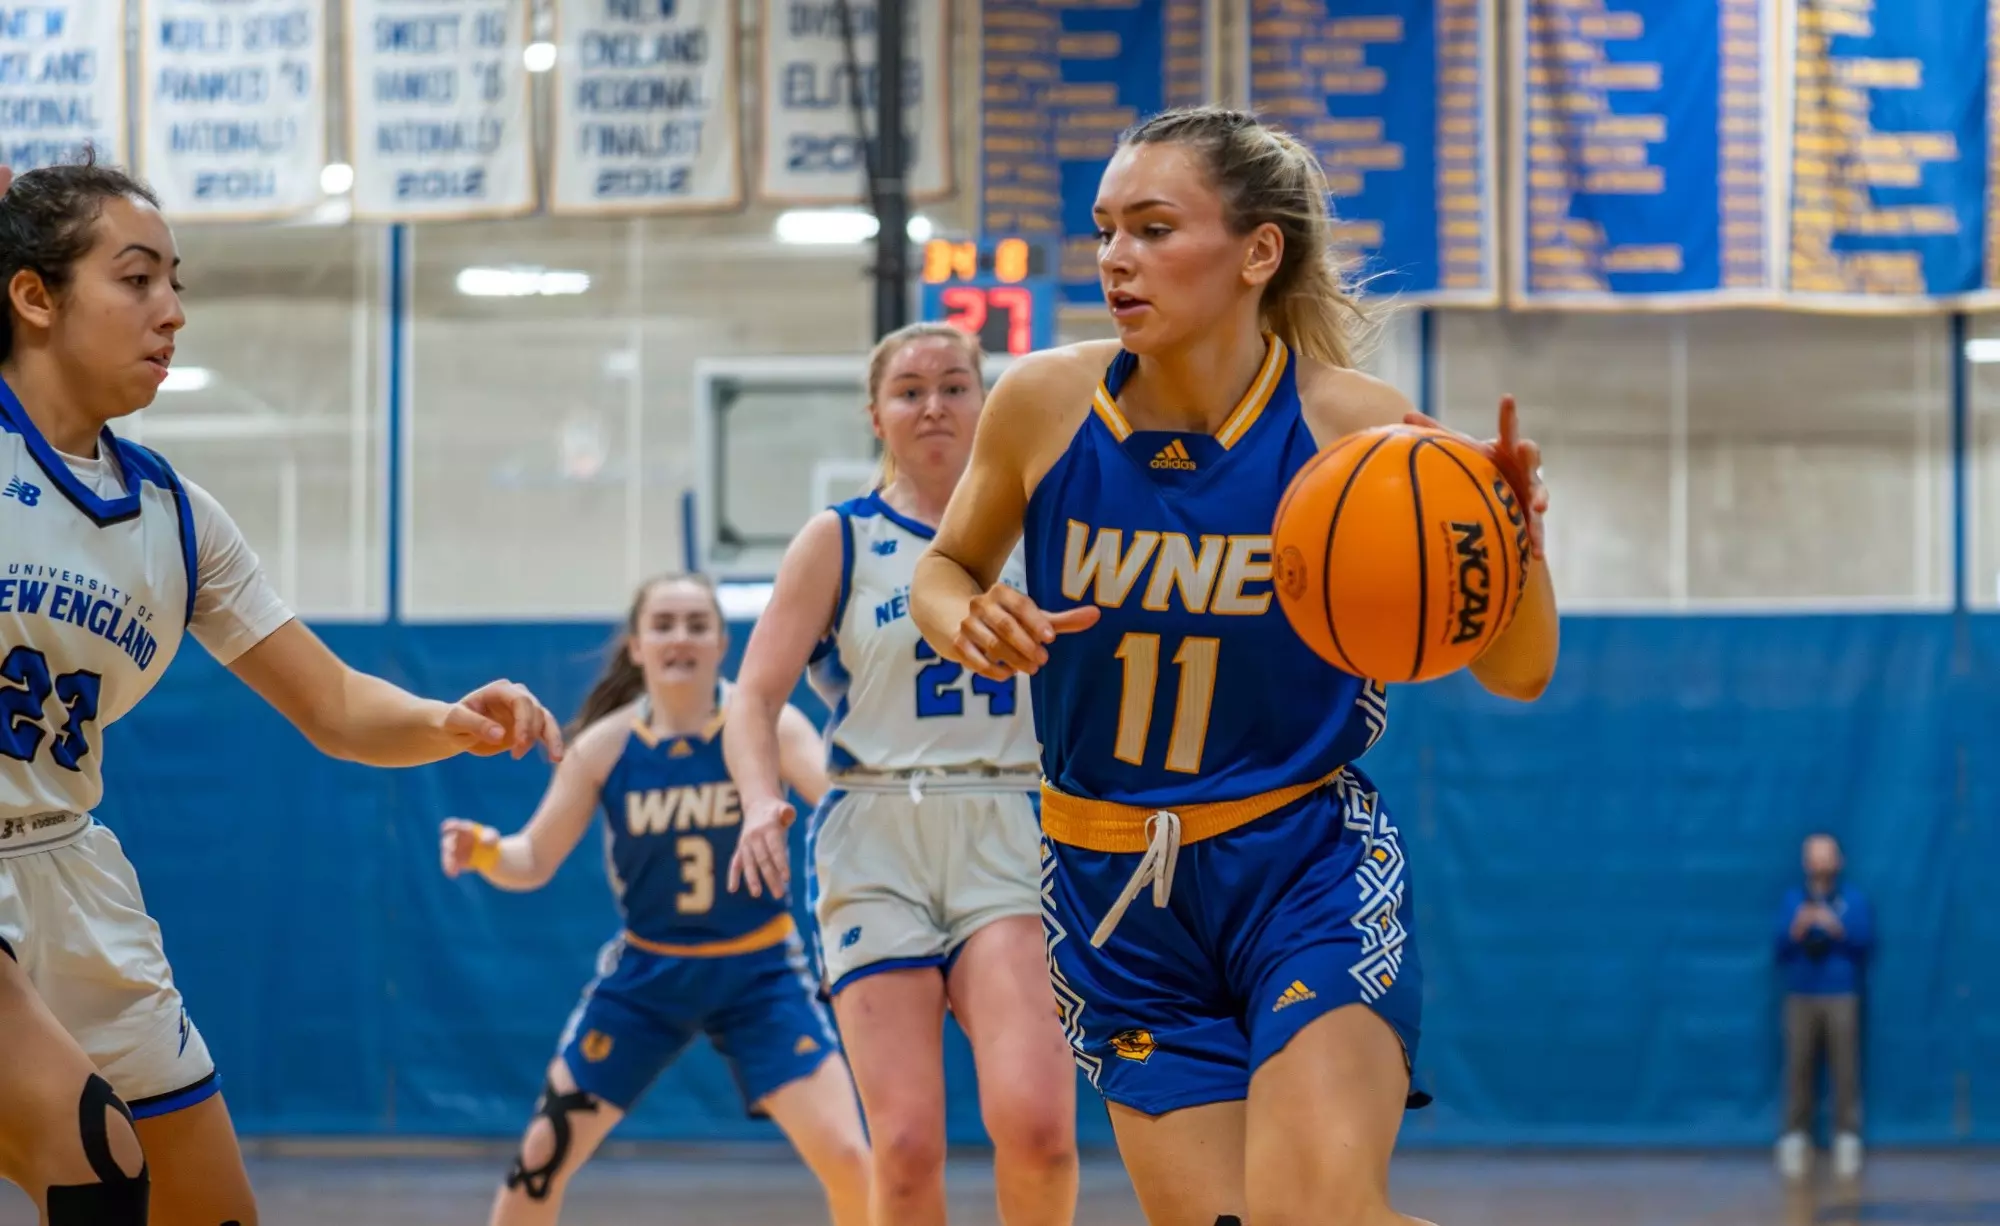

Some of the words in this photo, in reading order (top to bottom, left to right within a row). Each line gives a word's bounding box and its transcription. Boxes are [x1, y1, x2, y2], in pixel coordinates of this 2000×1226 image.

[942, 287, 1032, 356] 27
[1149, 459, 1197, 471] adidas
[9, 563, 132, 606] UNIVERSITY
[138, 605, 154, 622] OF
[1061, 518, 1274, 615] WNE
[1451, 521, 1491, 645] NCAA
[0, 579, 49, 614] EW
[49, 584, 158, 671] ENGLAND
[875, 595, 910, 628] NE
[0, 645, 102, 772] 23
[915, 634, 1016, 718] 24
[1114, 632, 1220, 774] 11
[626, 782, 743, 836] WNE
[676, 836, 714, 914] 3
